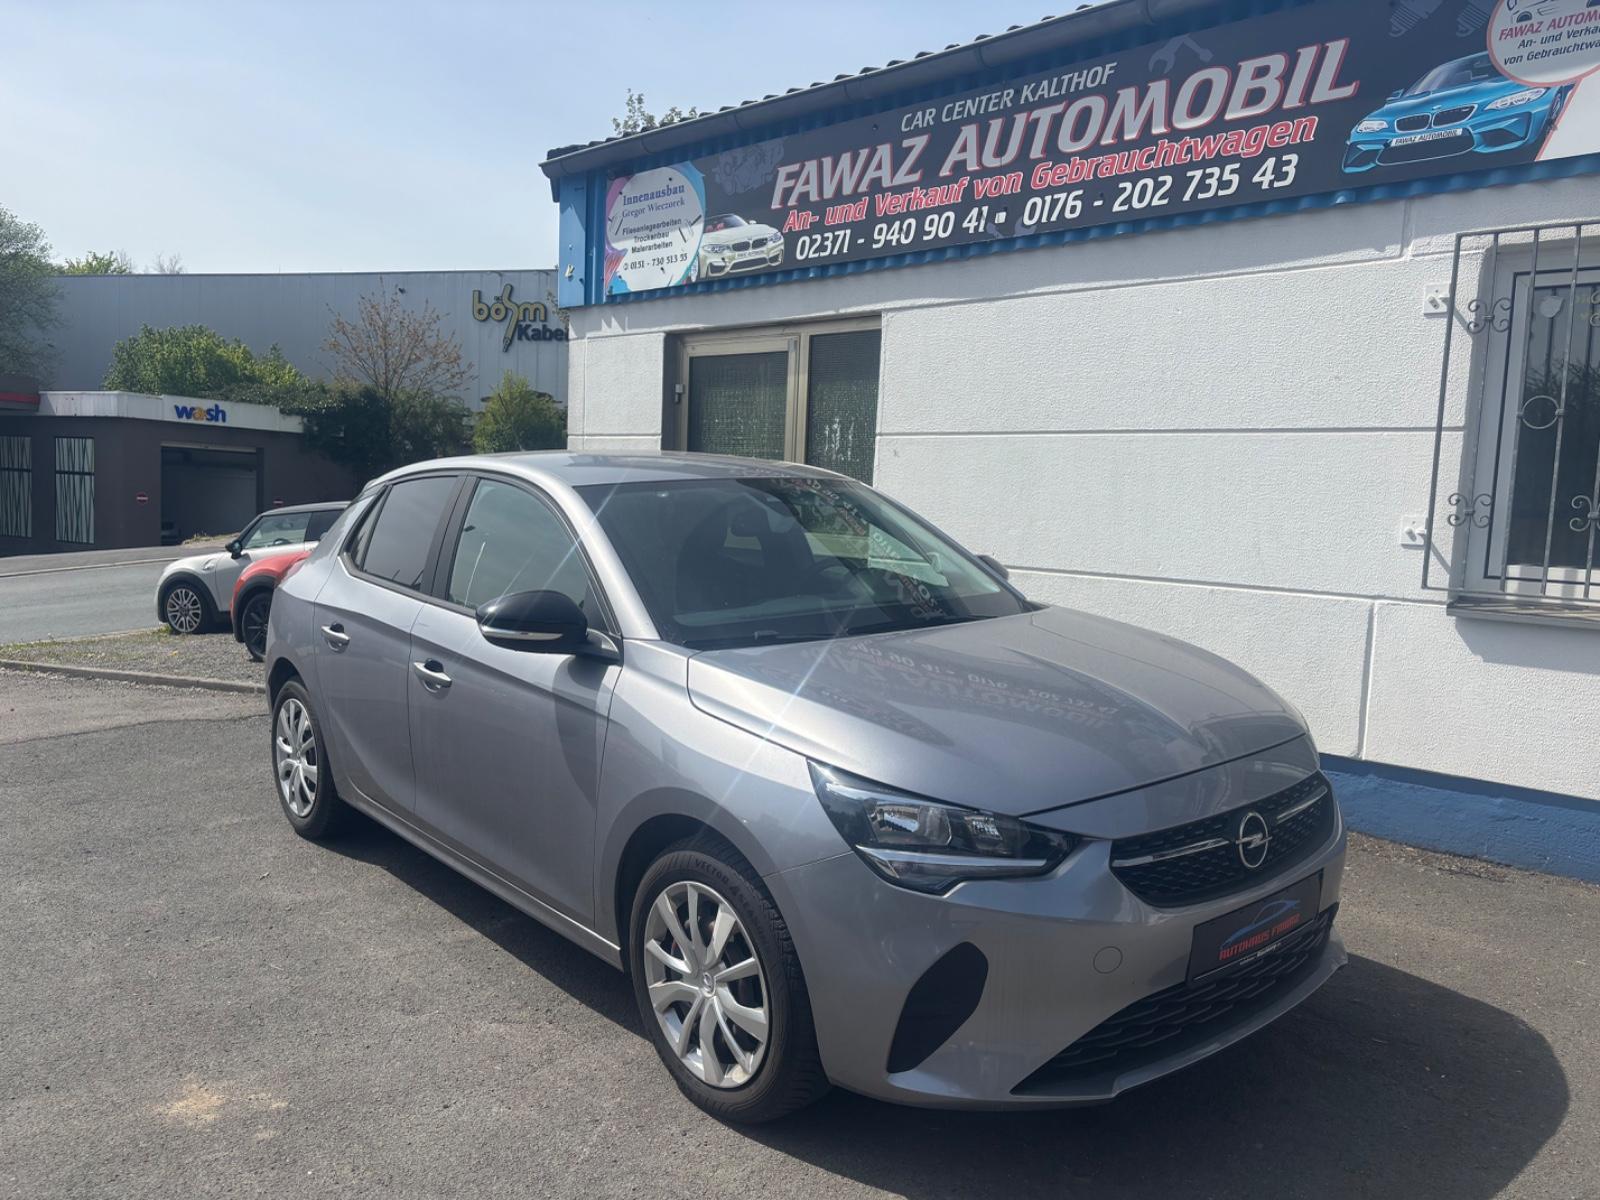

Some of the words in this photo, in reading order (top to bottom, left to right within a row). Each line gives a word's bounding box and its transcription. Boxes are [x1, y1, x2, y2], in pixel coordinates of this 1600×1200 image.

[1499, 21, 1543, 40] FAWAZ
[1547, 9, 1600, 31] AUTOM
[1518, 39, 1536, 48] An-
[1540, 32, 1563, 45] und
[1567, 25, 1600, 39] Verka
[1504, 55, 1524, 65] von
[901, 108, 936, 132] CAR
[941, 89, 1015, 123] CENTER
[1020, 62, 1118, 104] KALTHOF
[770, 133, 932, 210] FAWAZ
[939, 37, 1360, 178] AUTOMOBIL
[782, 209, 819, 233] An-
[825, 197, 869, 226] und
[875, 176, 970, 217] Verkauf
[973, 171, 1023, 200] von
[1031, 116, 1319, 190] Gebrauchtwagen
[623, 184, 685, 206] Innenausbau
[796, 229, 851, 260] 02371
[872, 218, 916, 249] 940
[923, 211, 956, 241] 90
[962, 205, 989, 234] 41
[1023, 189, 1084, 226] 0176
[1112, 175, 1173, 212] 202
[1182, 162, 1241, 202] 735
[1252, 153, 1299, 190] 43
[623, 207, 645, 218] Gregor
[632, 241, 673, 254] Malerarbeiten
[634, 231, 669, 243] Trockenbau
[174, 404, 226, 423] wash
[695, 859, 729, 884] VECTOR
